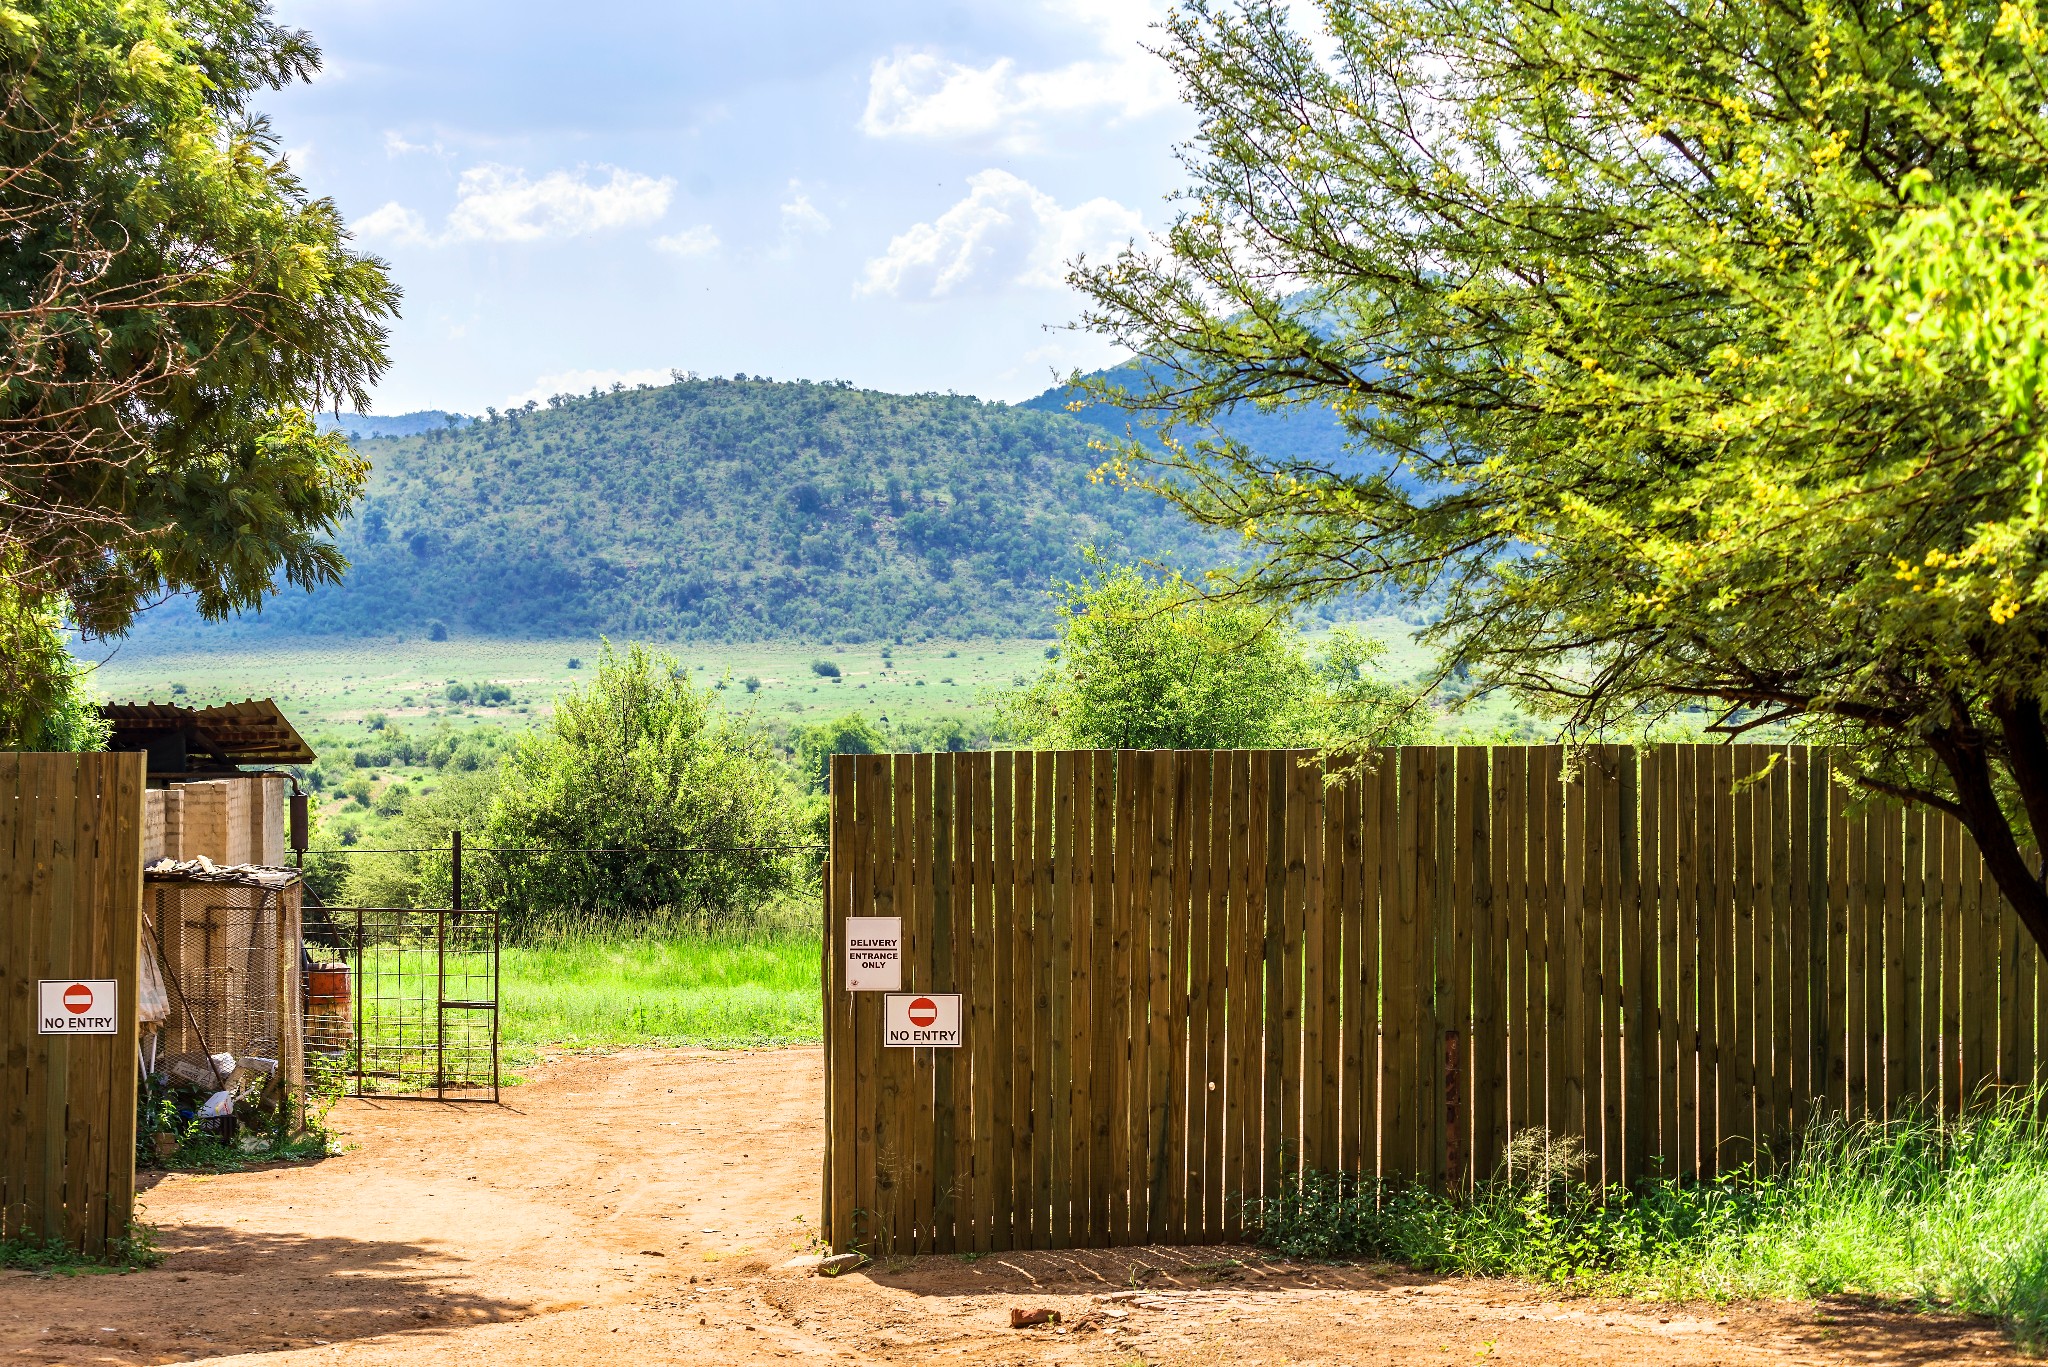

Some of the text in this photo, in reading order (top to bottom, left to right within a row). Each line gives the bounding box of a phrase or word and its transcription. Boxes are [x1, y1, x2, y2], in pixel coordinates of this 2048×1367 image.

[850, 939, 897, 947] DELIVERY
[862, 961, 886, 969] ONLY
[45, 1017, 112, 1028] NO ENTRY
[890, 1030, 956, 1041] NO ENTRY
